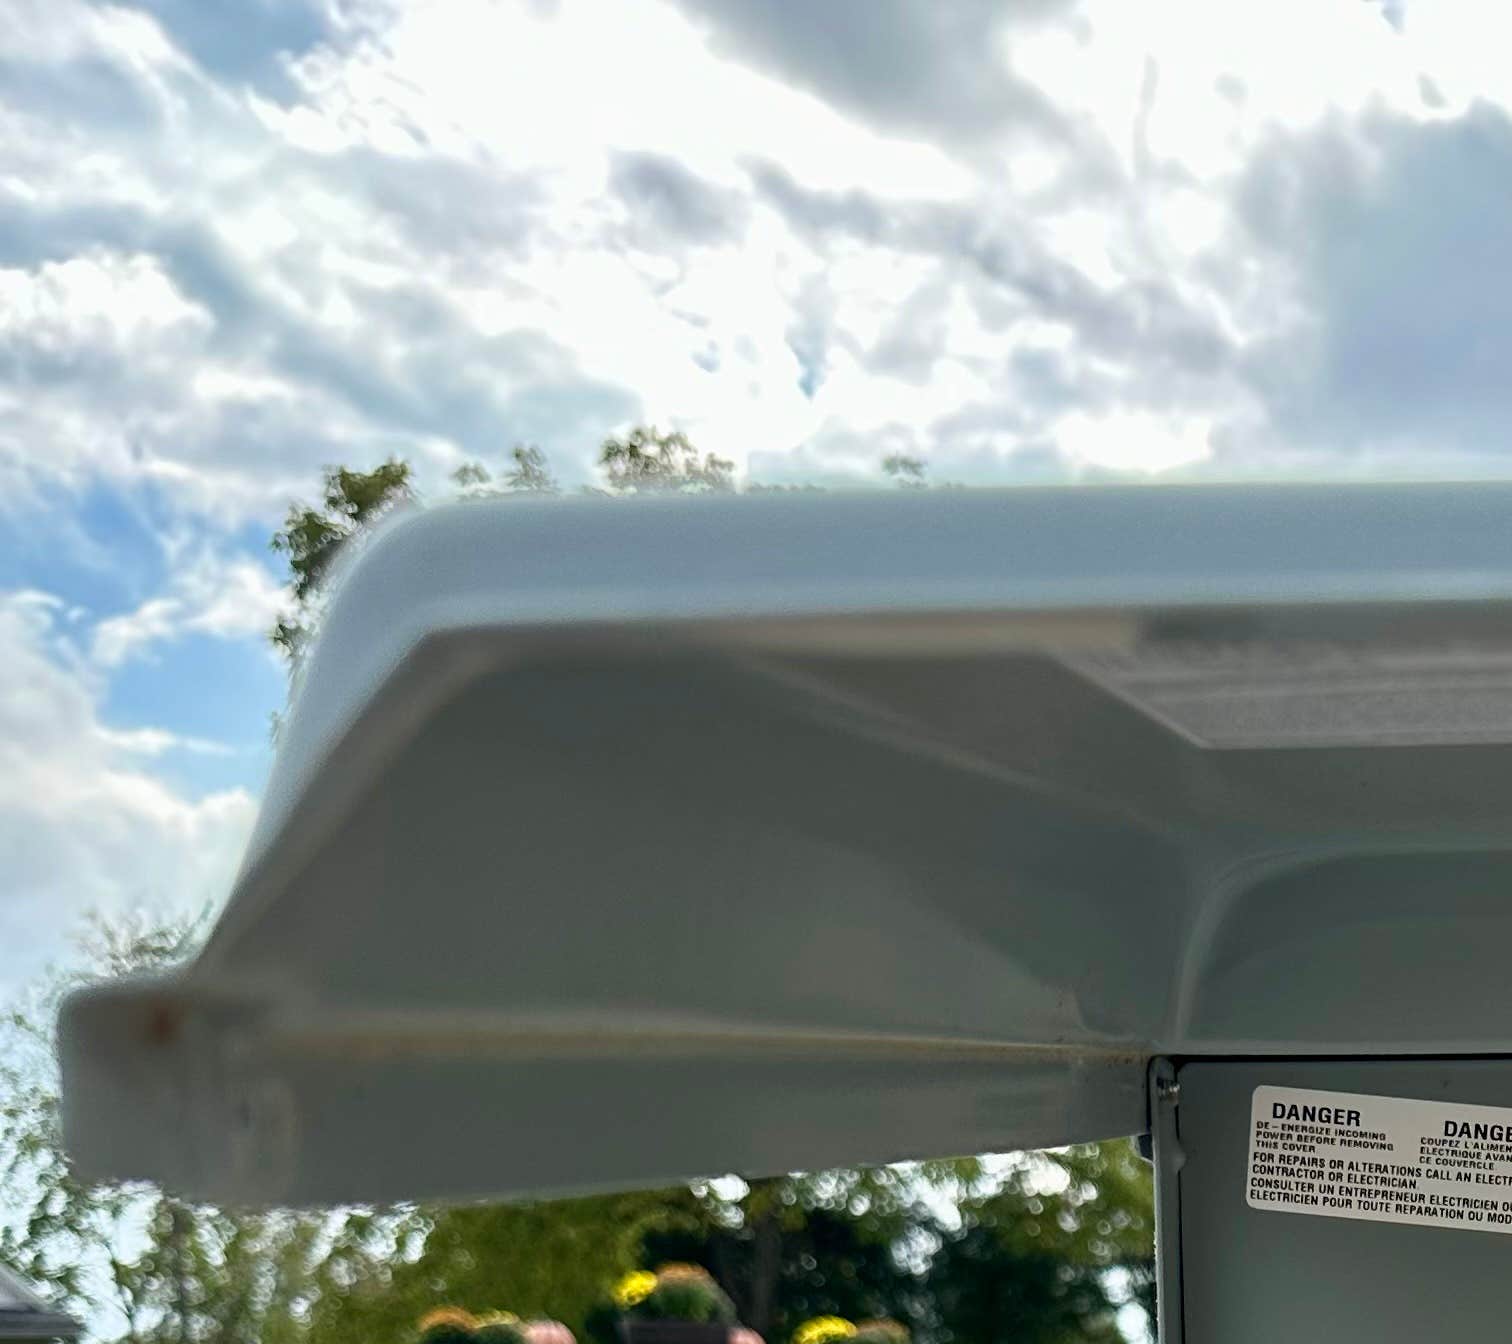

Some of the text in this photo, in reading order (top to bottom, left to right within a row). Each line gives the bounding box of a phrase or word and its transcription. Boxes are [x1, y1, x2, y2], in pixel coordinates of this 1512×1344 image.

[1272, 1103, 1360, 1126] DANGER
[1256, 1121, 1270, 1130] DE
[1335, 1129, 1386, 1140] INCOMING
[1256, 1130, 1293, 1141] POWER
[1340, 1139, 1394, 1151] REMOVING
[1256, 1140, 1279, 1149] THIS
[1421, 1137, 1460, 1148] COUPEZ
[1253, 1152, 1274, 1163] FOR
[1279, 1154, 1326, 1168] REPAIRS
[1329, 1160, 1344, 1170] OR
[1348, 1162, 1422, 1177] ALTERATIONS
[1426, 1169, 1452, 1181] CALL
[1456, 1172, 1472, 1182] AN
[1253, 1164, 1324, 1180] CONTRACTOR
[1328, 1172, 1343, 1182] OR
[1419, 1156, 1494, 1170] CE COUVERCLE
[1251, 1177, 1314, 1192] CONSULTER
[1319, 1184, 1335, 1195] UN
[1339, 1186, 1426, 1203] ENTREPRENEUR
[1430, 1195, 1498, 1210] ELECTRICIEN
[1250, 1189, 1318, 1205] ELECTRICIEN
[1322, 1196, 1352, 1208] POUR
[1357, 1200, 1391, 1213] TOUTE
[1395, 1204, 1464, 1219] REPARATION
[1468, 1211, 1483, 1222] OU
